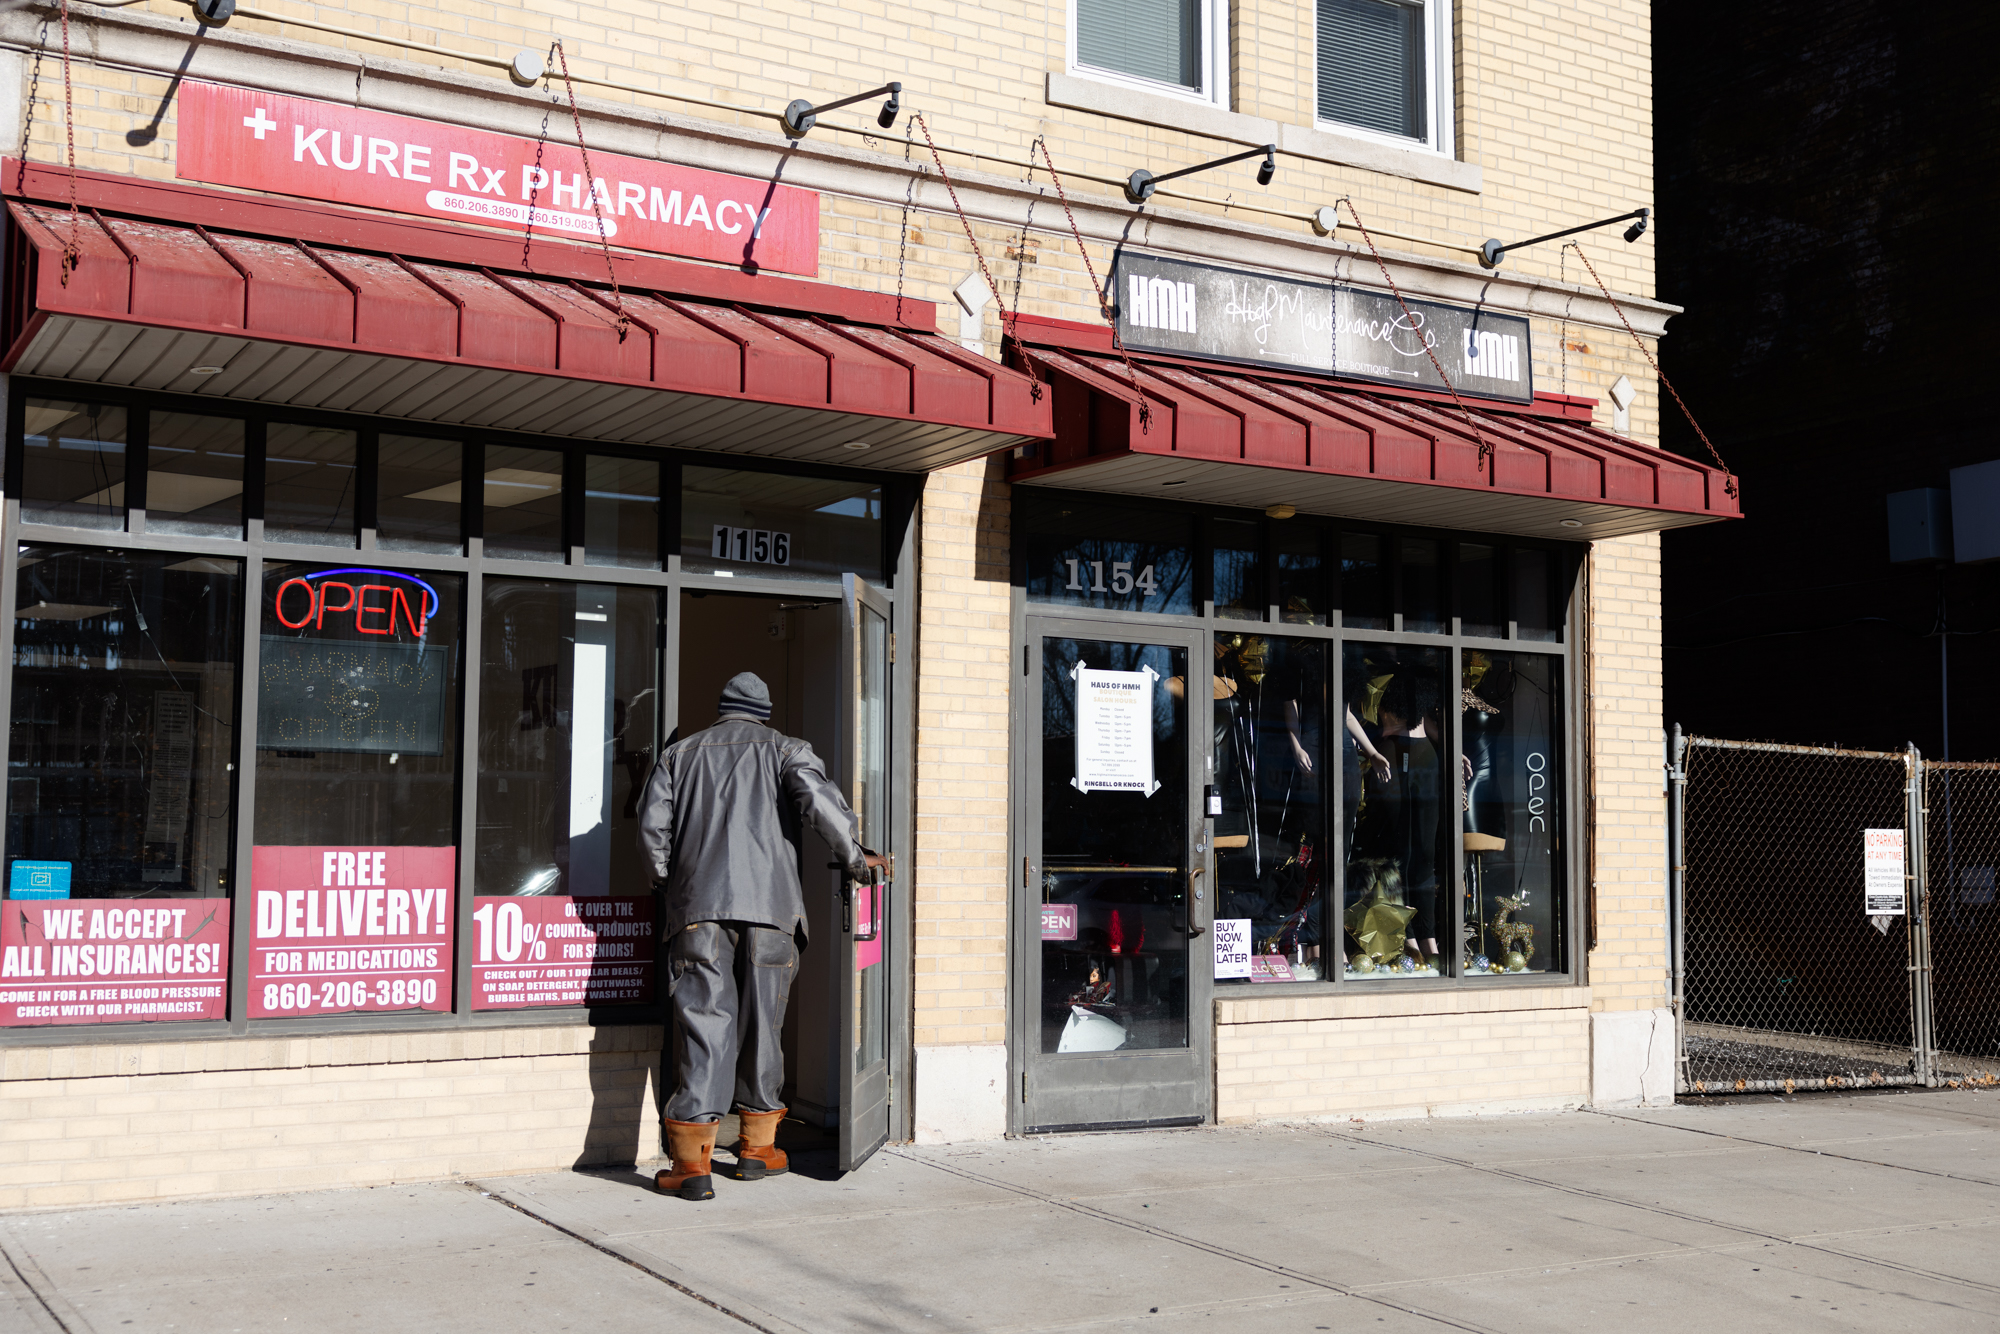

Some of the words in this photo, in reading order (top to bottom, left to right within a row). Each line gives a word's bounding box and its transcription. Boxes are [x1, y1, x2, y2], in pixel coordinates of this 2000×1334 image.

[293, 124, 432, 184] KURE
[448, 150, 505, 198] Rx
[521, 163, 773, 241] PHARMACY
[444, 196, 519, 219] 860.206.3890
[1129, 274, 1197, 334] HMH
[1225, 279, 1278, 344] High
[1279, 288, 1391, 350] Maintenance
[1291, 353, 1310, 365] FULL
[1313, 355, 1348, 370] SERVCE
[1350, 360, 1390, 376] BOUTIQUE
[1463, 328, 1520, 382] HMH
[716, 526, 789, 566] 1156
[1064, 558, 1158, 596] 1154
[275, 578, 428, 638] OPEN
[262, 652, 434, 695] PHARMACY
[1091, 681, 1110, 689] HAUS
[1122, 683, 1141, 691] HMH
[1084, 780, 1112, 788] RINGBELL
[1866, 833, 1875, 847] NO
[1876, 834, 1903, 847] PARKING
[1867, 850, 1874, 860] AT
[1875, 851, 1887, 860] ANY
[1888, 851, 1902, 861] TIME
[322, 851, 386, 887] FREE
[43, 909, 84, 940] WE
[89, 908, 187, 940] ACCEPT
[256, 888, 447, 939] DELIVERY!
[1041, 915, 1071, 929] PEN
[473, 902, 547, 962] 10%
[564, 902, 584, 918] OFF
[585, 902, 612, 917] OVER
[614, 902, 634, 917] THE
[545, 922, 595, 939] COUNTER
[596, 921, 652, 937] PRODUCTS
[1216, 922, 1236, 932] BUY
[1216, 932, 1243, 943] NOW,
[563, 943, 584, 959] FOR
[585, 942, 634, 958] SENIORS!
[1216, 943, 1235, 953] PAY
[1216, 953, 1248, 964] LATER
[1, 945, 45, 977] ALL
[51, 943, 221, 976] INSURANCES!
[265, 951, 303, 973] FOR
[307, 947, 438, 971] MEDICATIONS
[483, 970, 517, 980] CHECK
[518, 969, 538, 979] OUT
[546, 968, 567, 978] OUR
[567, 968, 573, 977] 1
[574, 967, 610, 977] DOLLAR
[0, 990, 36, 1003] COME
[39, 990, 51, 1002] IN
[53, 989, 77, 1001] FOR
[79, 989, 88, 1001] A
[91, 988, 118, 1000] FREE
[120, 987, 159, 1000] BLOOD
[162, 986, 221, 999] PRESSURE
[263, 978, 437, 1010] 860-206-3890
[482, 983, 497, 992] ON
[498, 981, 525, 992] SOAP,
[526, 980, 580, 991] DETERGENT,
[487, 993, 526, 1003] BUBBLE
[527, 992, 560, 1002] BATHS,
[562, 991, 587, 1001] BODY
[589, 990, 618, 999] WASH
[16, 1005, 59, 1018] CHECK
[60, 1004, 95, 1017] WITH
[99, 1003, 123, 1015] OUR
[124, 1001, 204, 1015] PHARMACIST.
